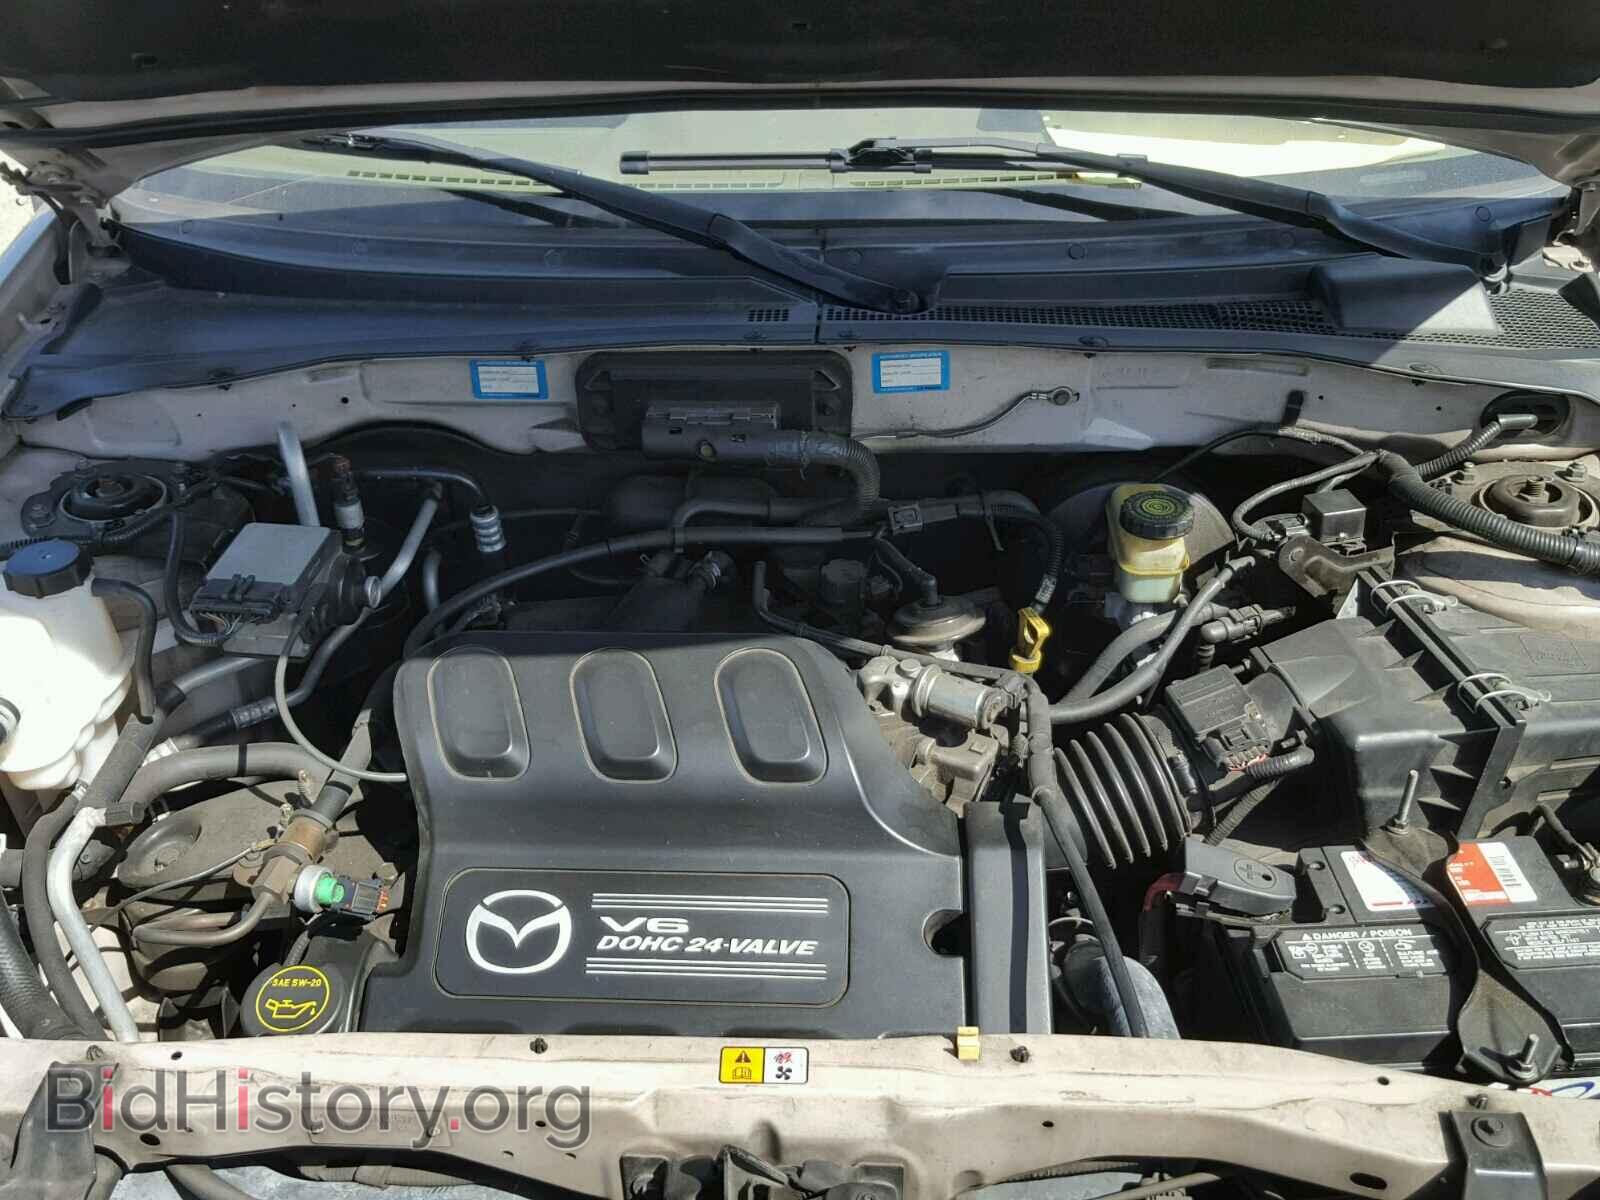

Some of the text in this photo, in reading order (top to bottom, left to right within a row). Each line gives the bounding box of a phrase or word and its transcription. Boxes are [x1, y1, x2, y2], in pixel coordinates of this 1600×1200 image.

[600, 916, 689, 934] V6
[1312, 931, 1359, 940] DANGER
[1370, 929, 1413, 938] POISON
[597, 935, 818, 956] DOHC 24-VALVE
[272, 978, 321, 987] SAE 5W-20
